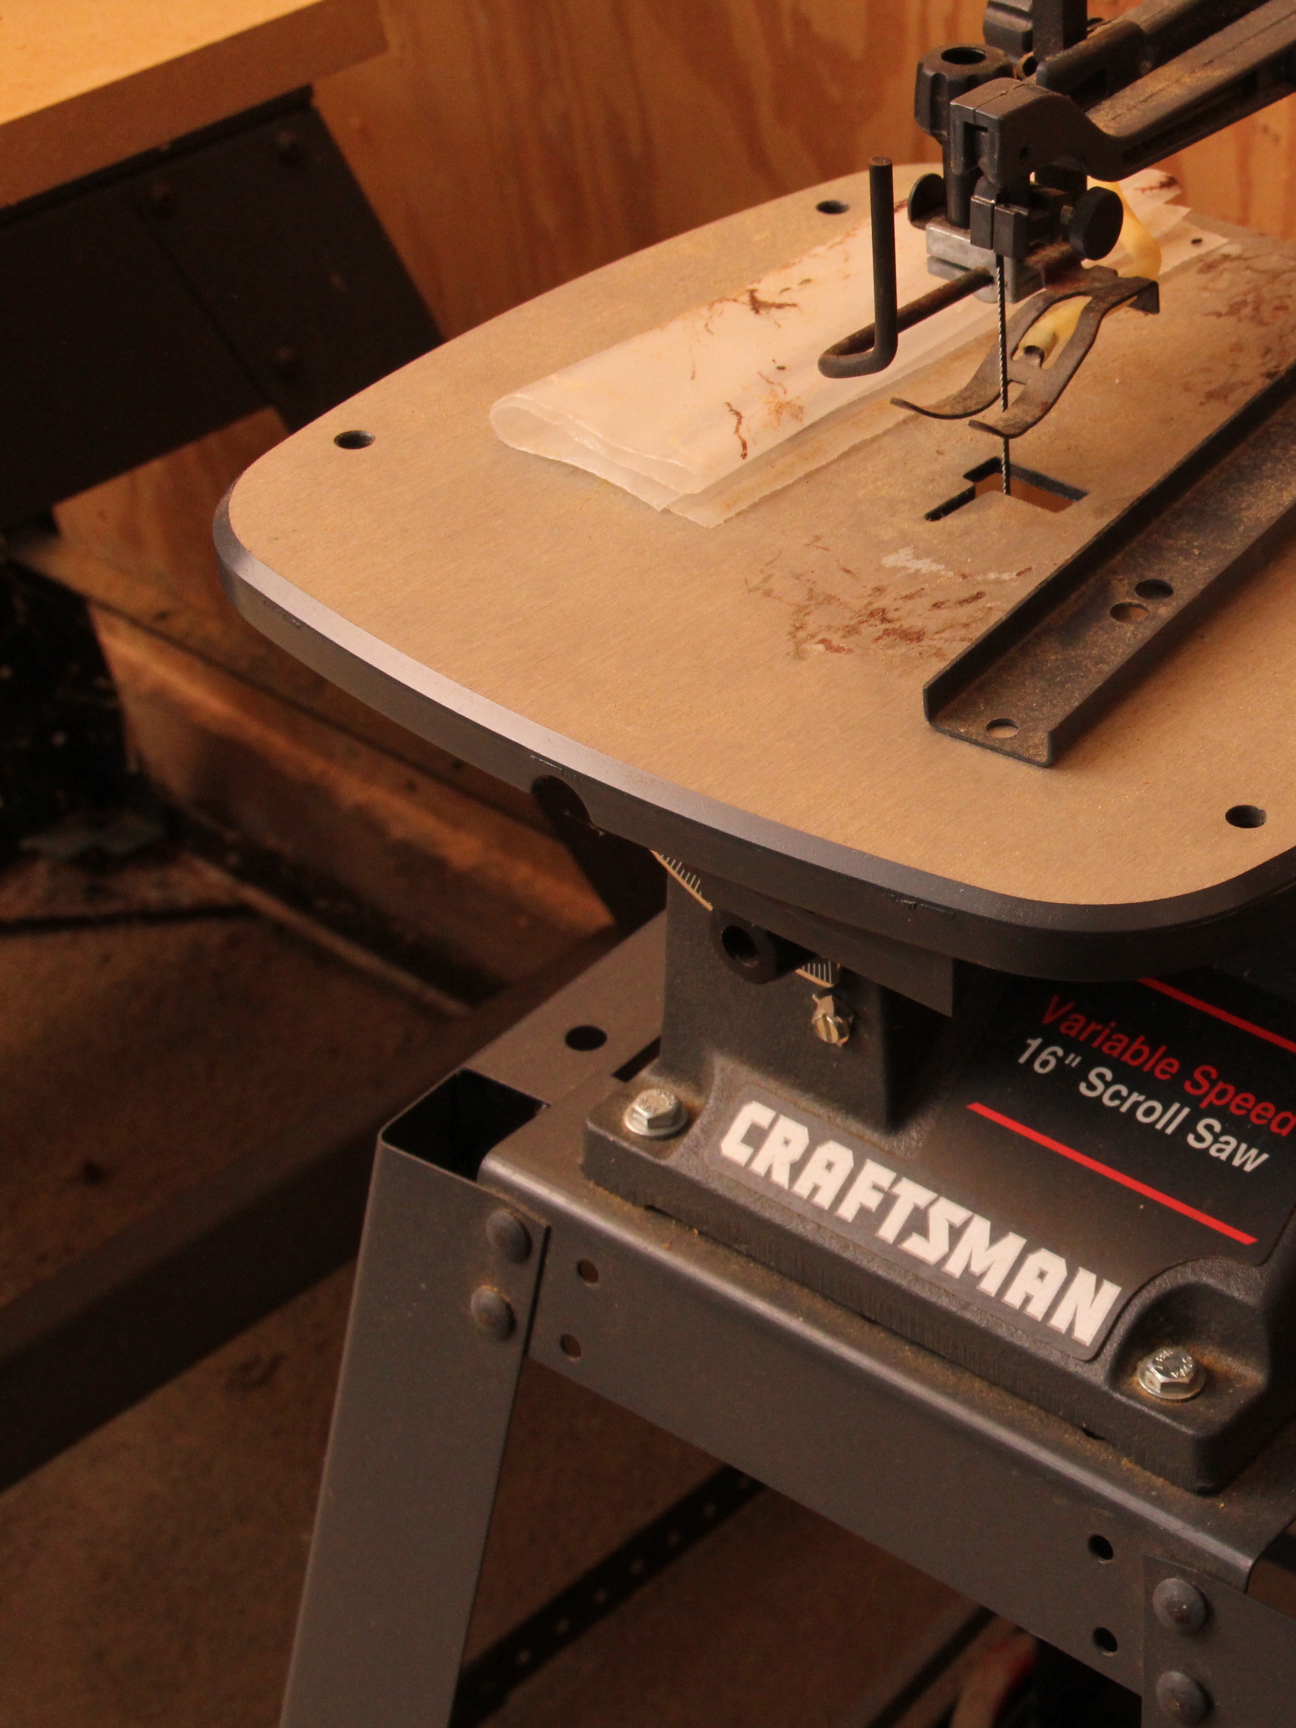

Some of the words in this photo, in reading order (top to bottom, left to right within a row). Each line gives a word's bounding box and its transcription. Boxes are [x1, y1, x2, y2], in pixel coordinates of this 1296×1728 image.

[1017, 1036, 1082, 1075] 16"
[1078, 1066, 1191, 1136] Scroll
[1187, 1118, 1270, 1174] Saw
[1041, 994, 1182, 1080] Variable
[719, 1100, 1122, 1347] CRAFTSMAN
